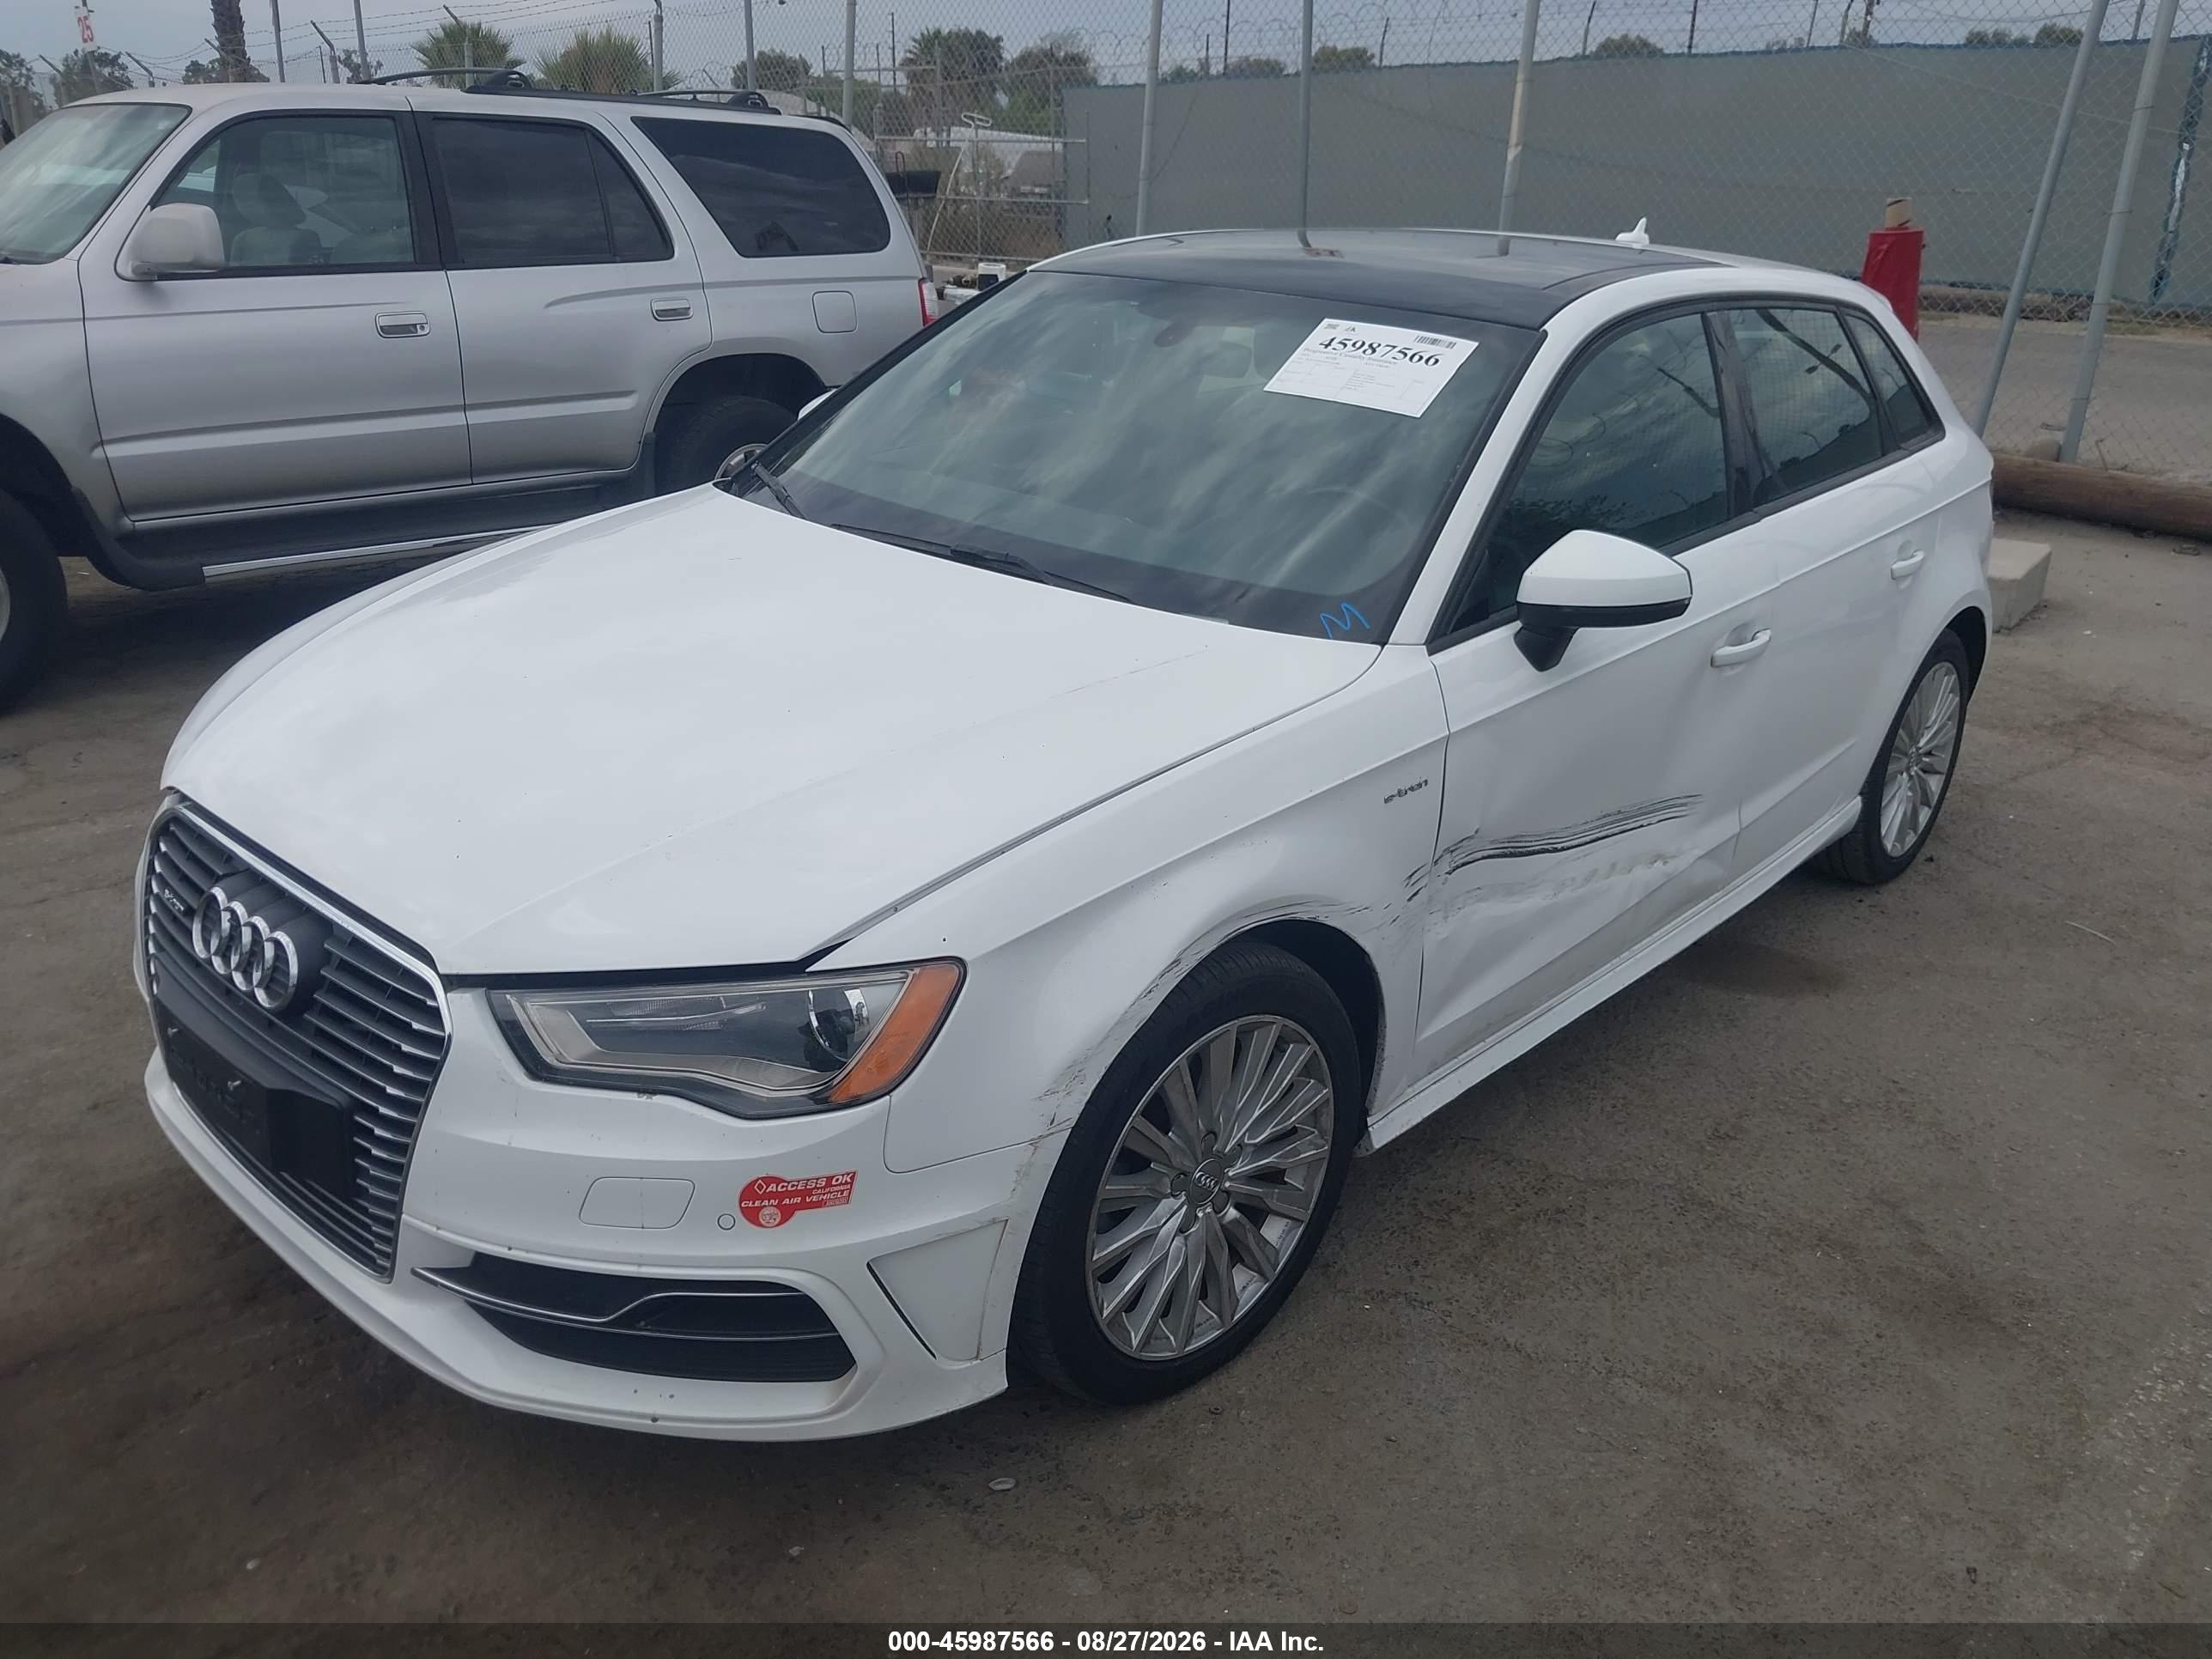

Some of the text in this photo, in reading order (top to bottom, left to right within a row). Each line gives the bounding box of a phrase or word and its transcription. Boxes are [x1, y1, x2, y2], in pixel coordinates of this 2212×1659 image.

[77, 15, 94, 43] 25
[1319, 336, 1443, 368] 45987566
[1319, 602, 1370, 640] M
[766, 1172, 854, 1193] ACCESS OK
[812, 1184, 851, 1194] CALIFORNIA
[741, 1199, 779, 1207] CLEAN
[782, 1196, 801, 1205] AIR
[806, 1190, 850, 1203] VEHICLE
